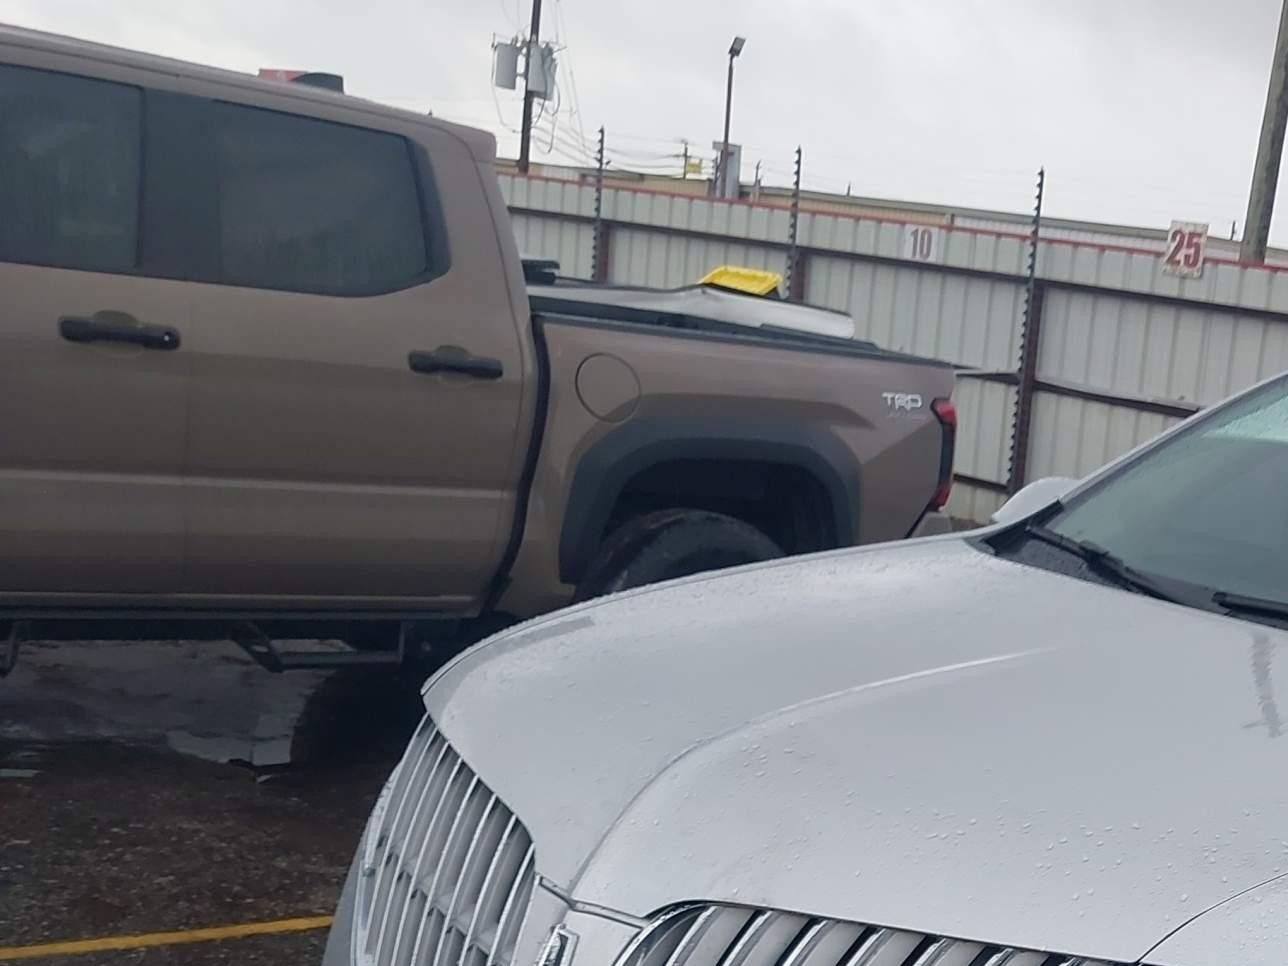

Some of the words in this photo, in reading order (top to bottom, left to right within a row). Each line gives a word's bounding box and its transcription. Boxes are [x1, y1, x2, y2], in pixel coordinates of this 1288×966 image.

[911, 228, 932, 260] 10
[1166, 229, 1203, 268] 25
[881, 391, 922, 411] TRD
